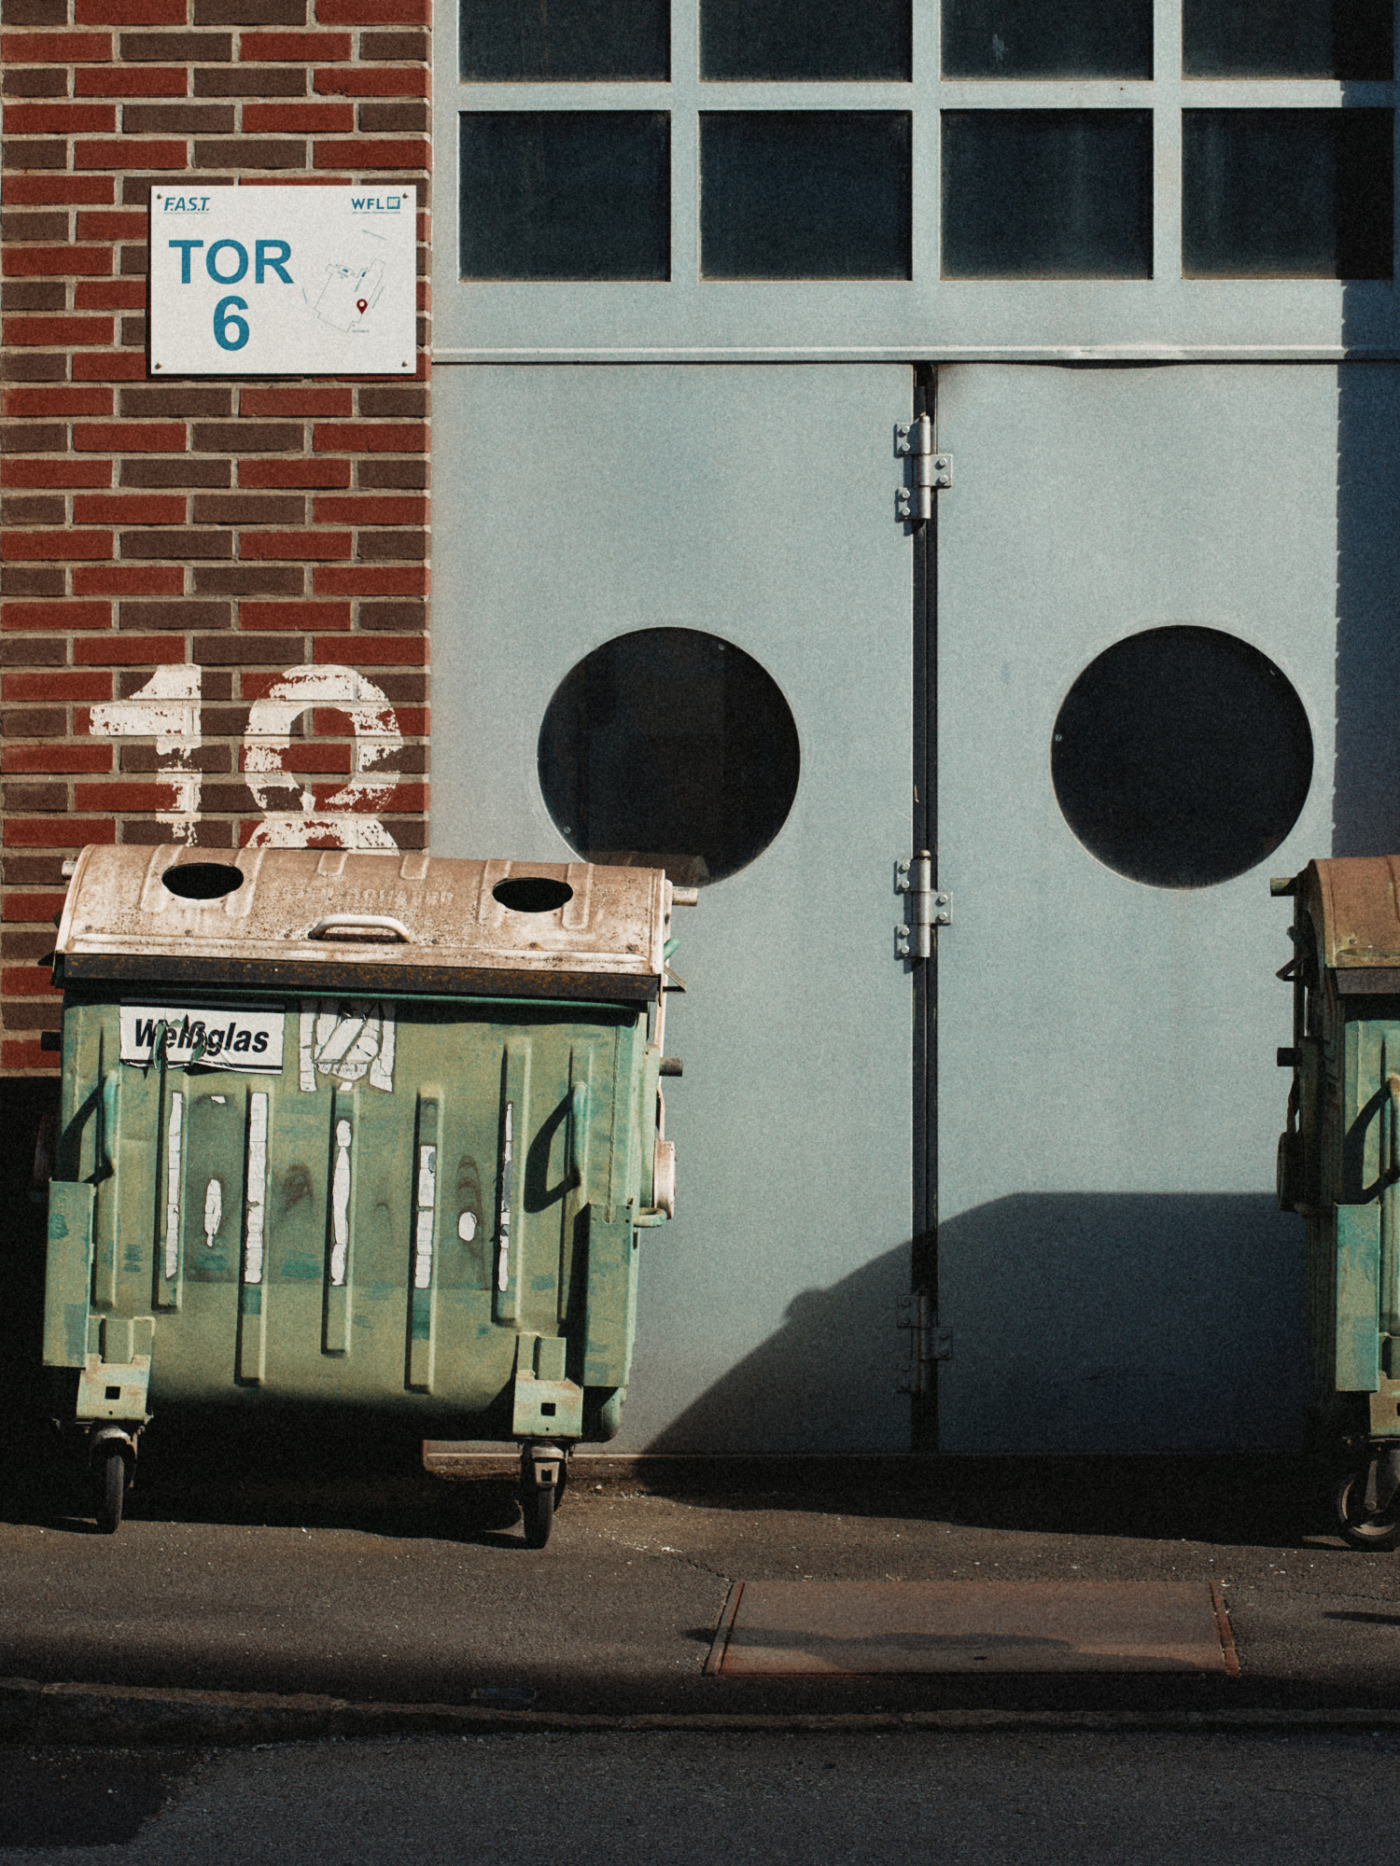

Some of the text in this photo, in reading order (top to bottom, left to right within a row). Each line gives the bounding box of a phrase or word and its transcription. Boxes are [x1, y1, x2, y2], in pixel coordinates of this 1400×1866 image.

[164, 197, 211, 211] F.A.S.T.
[351, 198, 385, 210] WFL
[168, 238, 294, 285] TOR
[213, 295, 250, 351] 6
[135, 1018, 270, 1057] Weißglas
